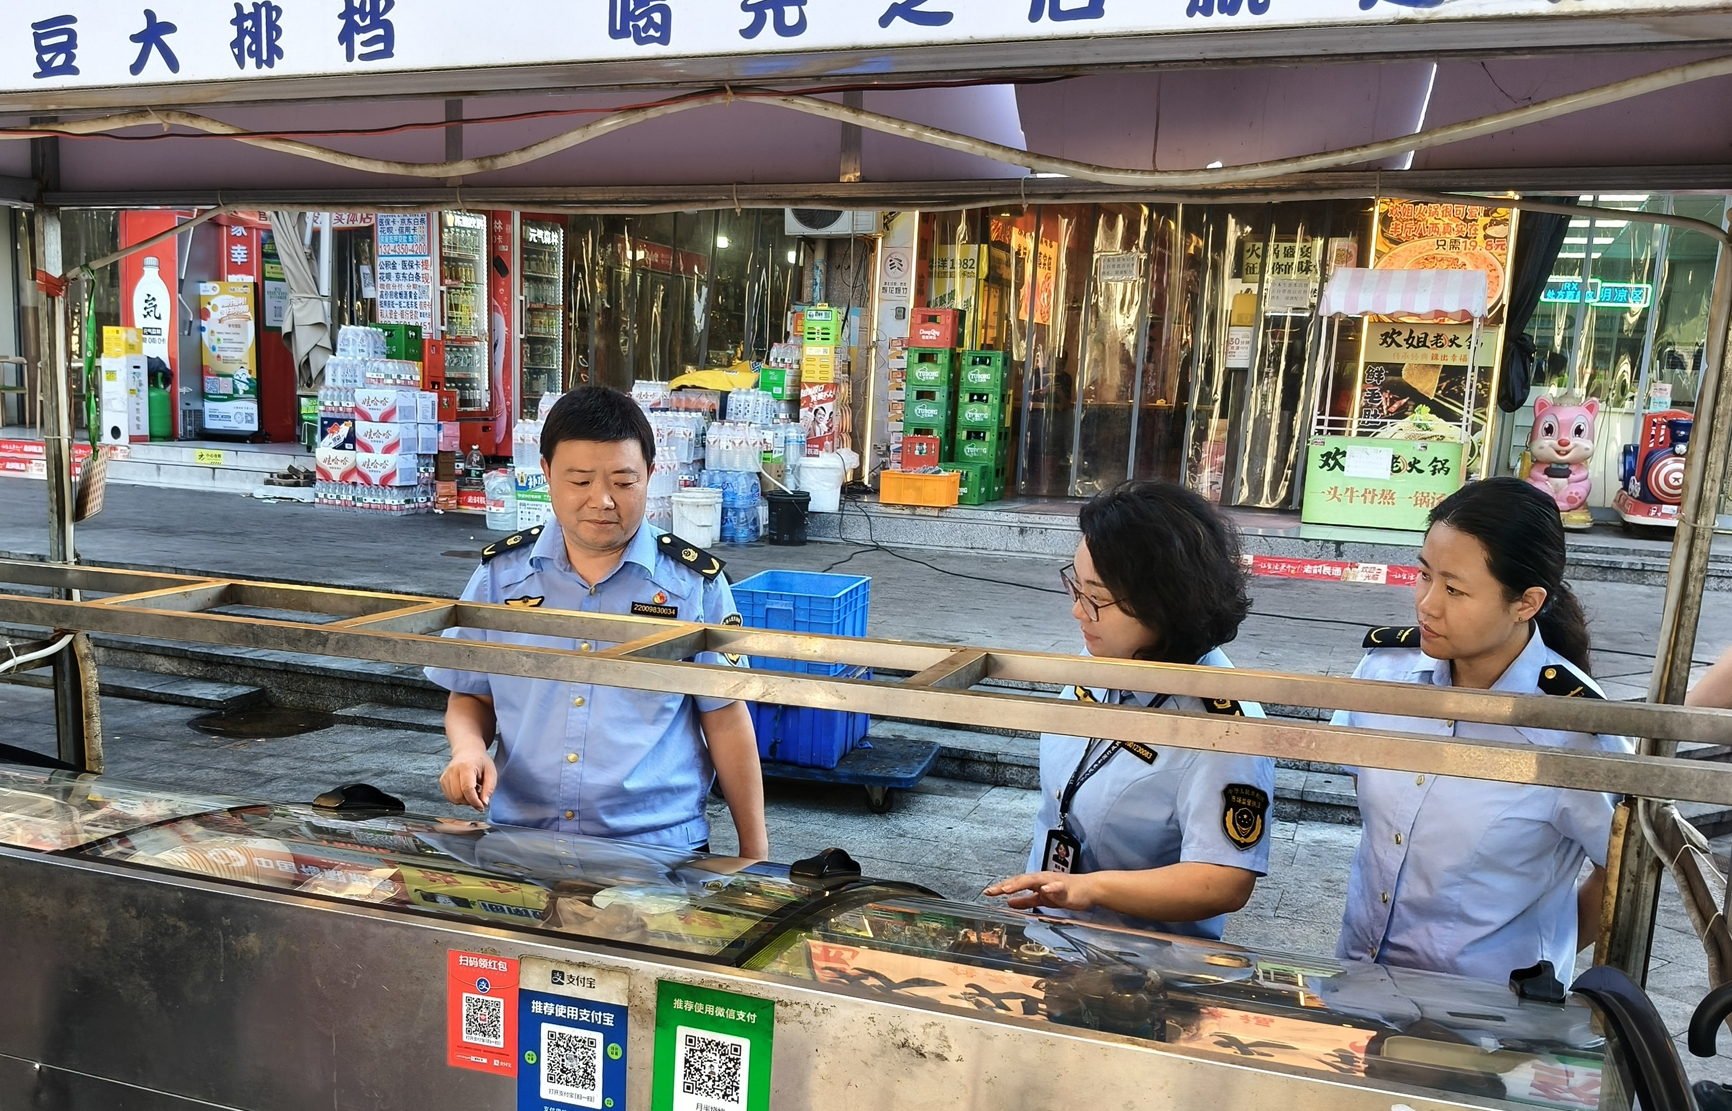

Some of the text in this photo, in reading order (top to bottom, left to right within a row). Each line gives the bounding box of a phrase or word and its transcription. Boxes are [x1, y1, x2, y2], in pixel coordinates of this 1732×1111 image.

[1388, 203, 1485, 220] 欢姐火锅很可爱!
[528, 227, 559, 246] 元气森林
[1389, 221, 1480, 237] 半斤八两真实在
[1435, 239, 1507, 251] 只需19.8元
[361, 395, 389, 407] 娃哈哈
[363, 428, 392, 440] 娃哈哈
[322, 455, 349, 466] 娃哈哈
[361, 458, 389, 470] 娃哈哈
[1318, 447, 1451, 476] 欢老火锅
[633, 603, 676, 616] 22009830034
[458, 954, 508, 973] 扫码领红包
[565, 973, 596, 989] 支付宝
[531, 999, 615, 1027] 推荐使用支付宝
[673, 998, 757, 1024] 推荐使用微信支付
